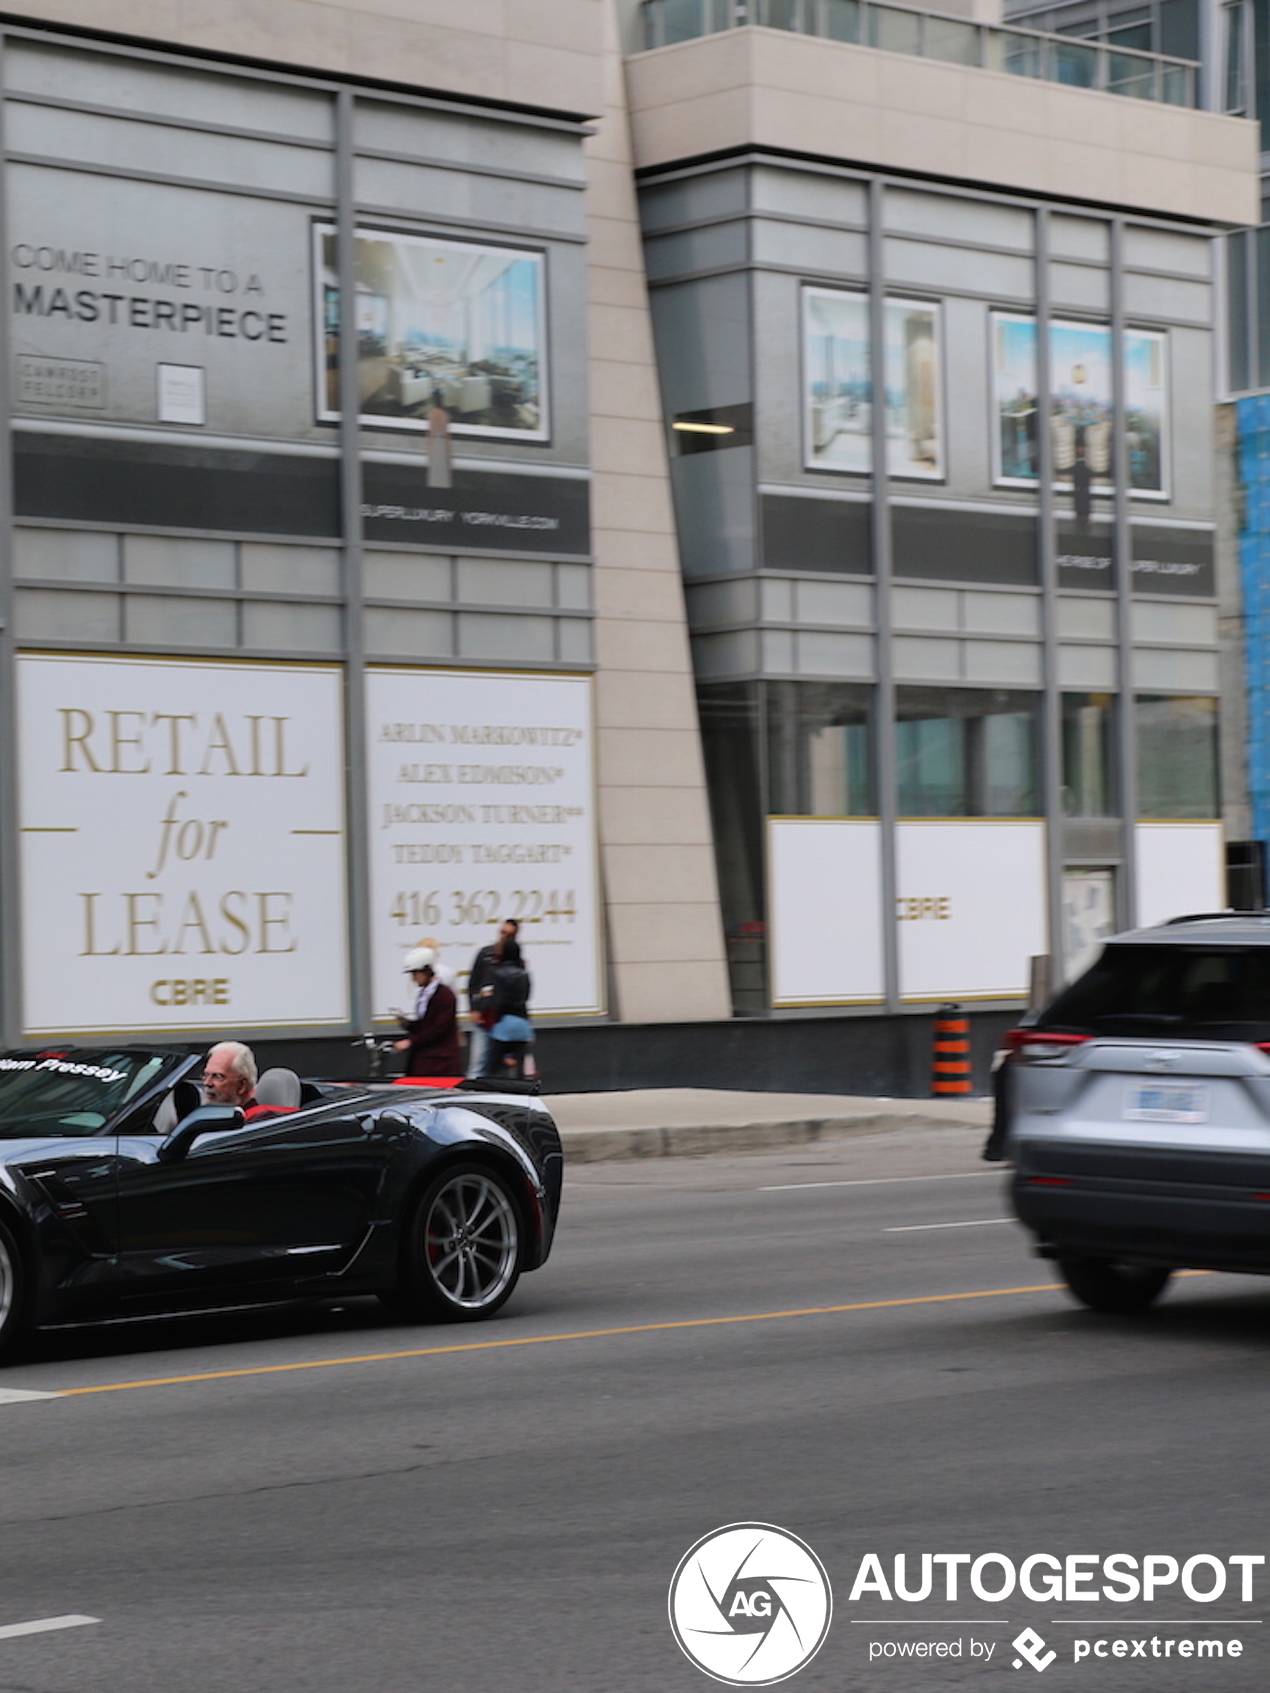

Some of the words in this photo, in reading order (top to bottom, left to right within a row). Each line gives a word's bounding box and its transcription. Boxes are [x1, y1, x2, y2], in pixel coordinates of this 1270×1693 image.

[12, 244, 100, 277] COME
[106, 254, 192, 289] HOME
[197, 267, 239, 294] TO
[242, 274, 265, 298] A
[13, 283, 288, 344] MASTERPIECE
[55, 708, 310, 778] RETAIL
[378, 722, 447, 744] ARLIN
[396, 763, 454, 784] ALEX
[145, 790, 229, 880] for
[380, 803, 477, 830] JACKSON
[390, 843, 468, 864] TEDDY
[76, 889, 299, 957] LEASE
[390, 889, 441, 926] 416
[149, 977, 230, 1006] CBRE
